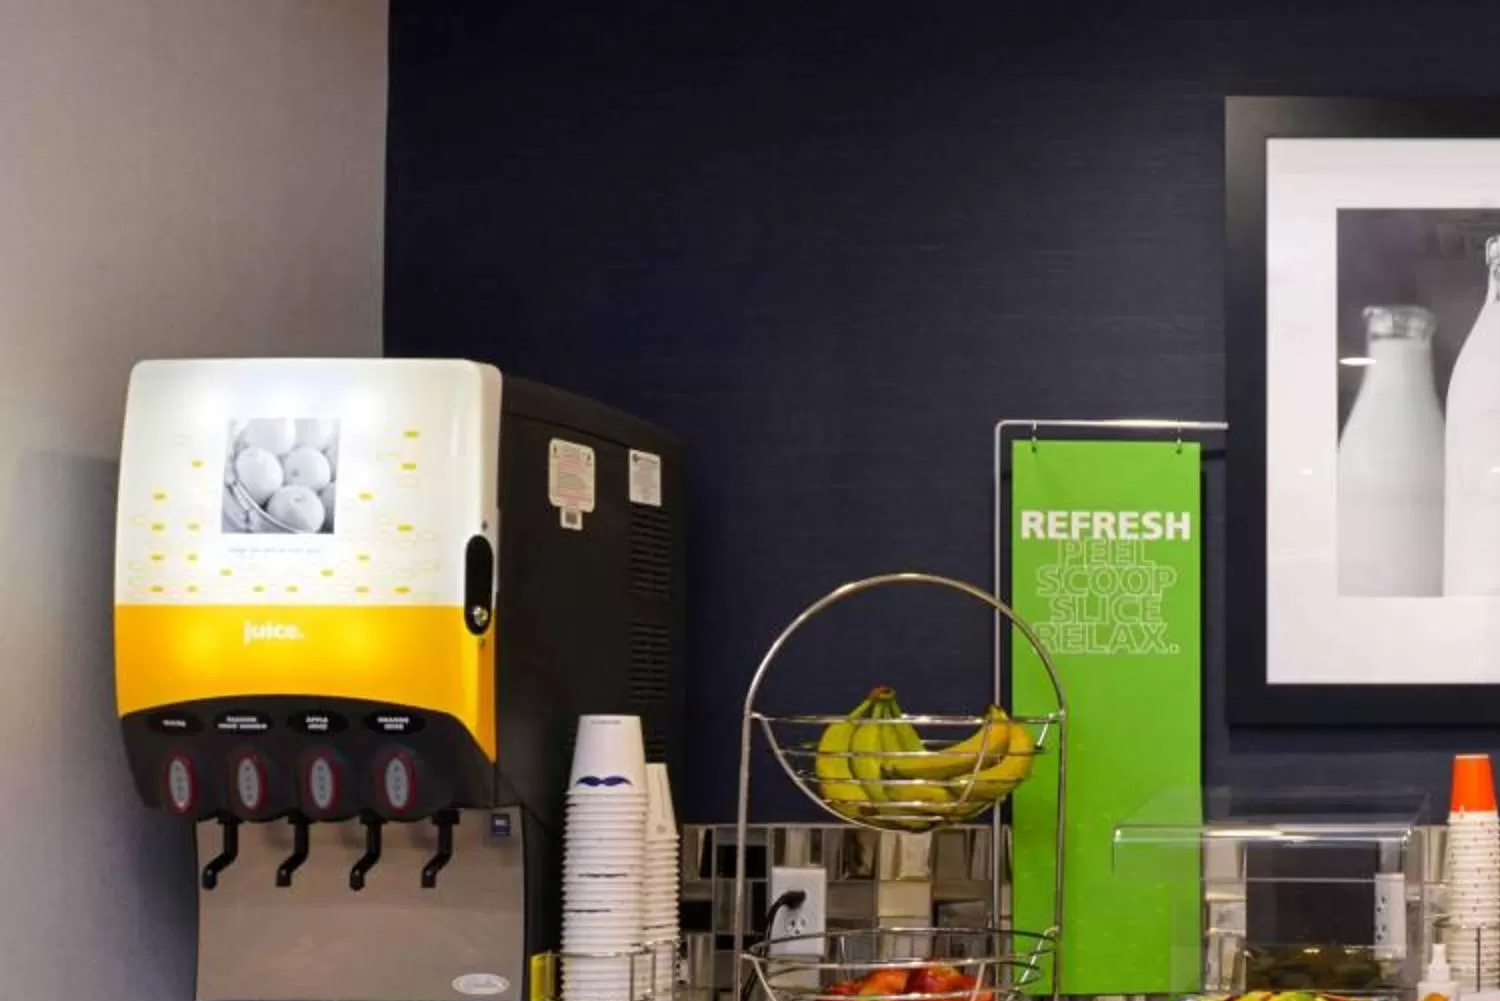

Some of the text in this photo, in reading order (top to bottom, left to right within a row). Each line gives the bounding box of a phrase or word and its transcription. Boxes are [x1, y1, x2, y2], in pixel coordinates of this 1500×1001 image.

[1021, 510, 1191, 541] REFRESH
[1057, 537, 1156, 568] PEEL
[1036, 564, 1177, 597] SCOOP
[1049, 595, 1164, 625] SLICE
